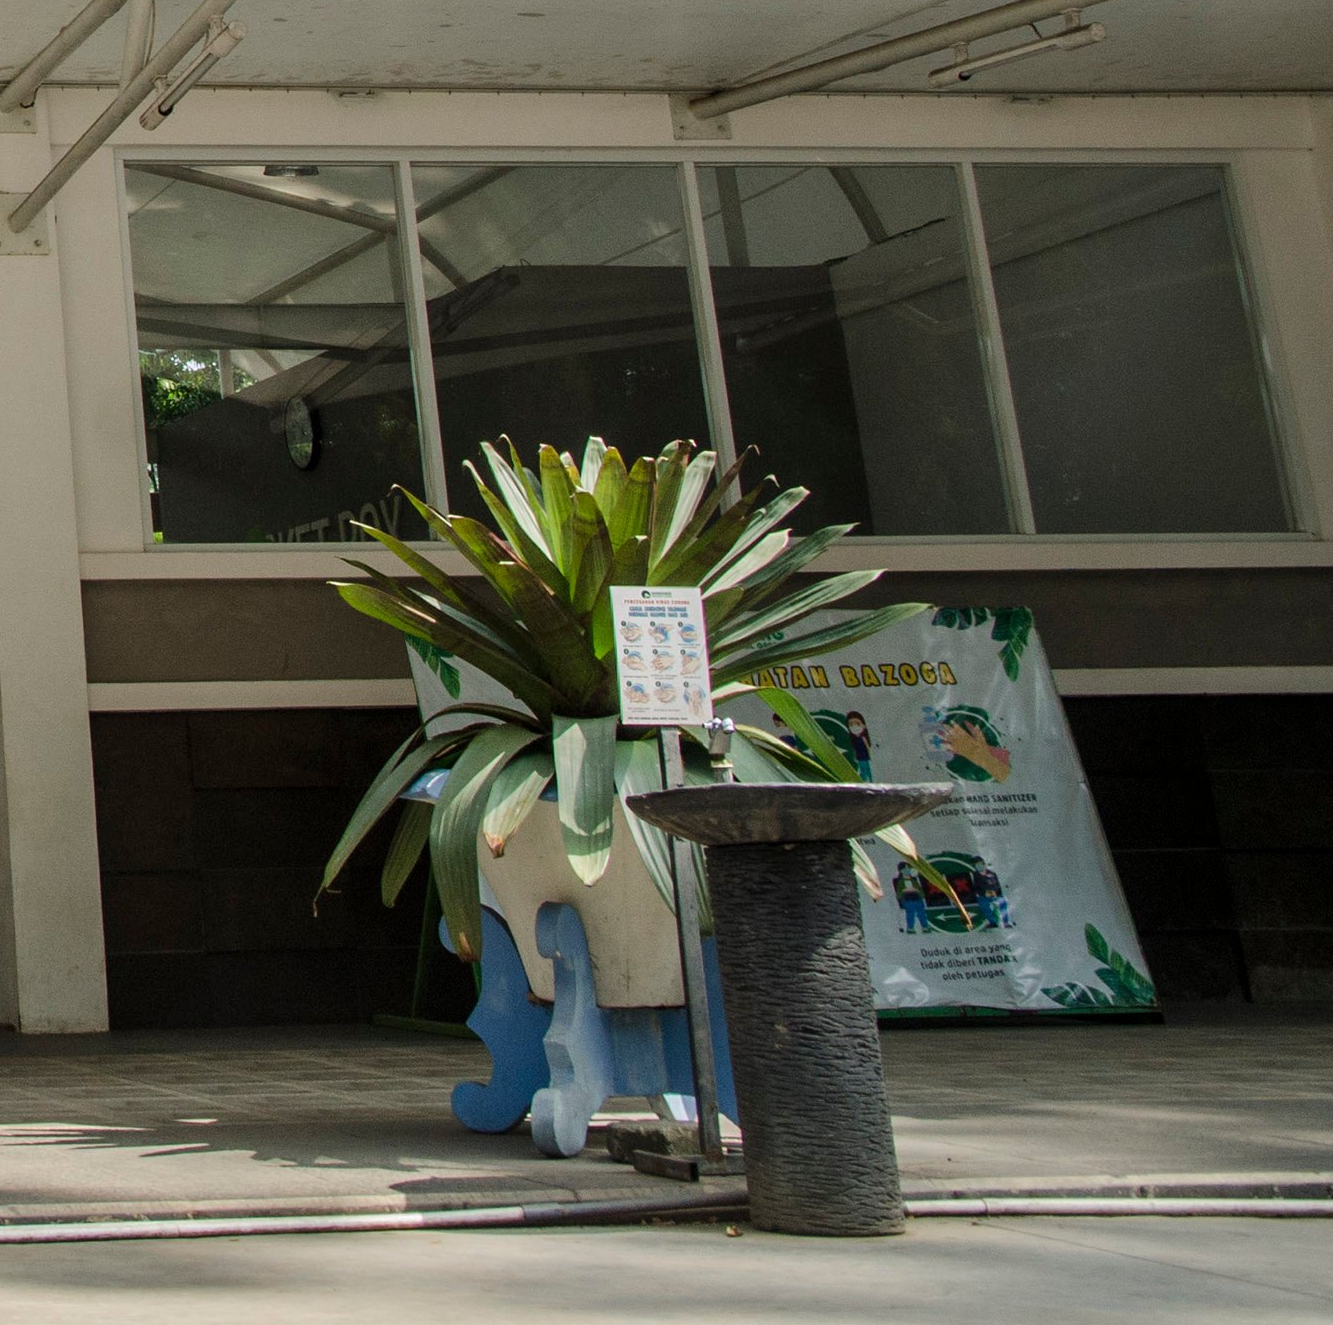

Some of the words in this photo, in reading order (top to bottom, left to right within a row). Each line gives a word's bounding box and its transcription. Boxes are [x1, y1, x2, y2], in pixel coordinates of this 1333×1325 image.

[839, 661, 957, 687] BAZOGA
[993, 793, 1038, 803] SANITIZER
[920, 947, 951, 958] Duduk
[953, 946, 963, 955] di
[964, 945, 986, 955] area
[988, 943, 1011, 955] yang
[920, 959, 945, 970] tidak
[946, 957, 976, 968] diberi
[977, 955, 1010, 966] TANDA
[942, 971, 964, 981] oleh
[965, 969, 1006, 982] petugas
